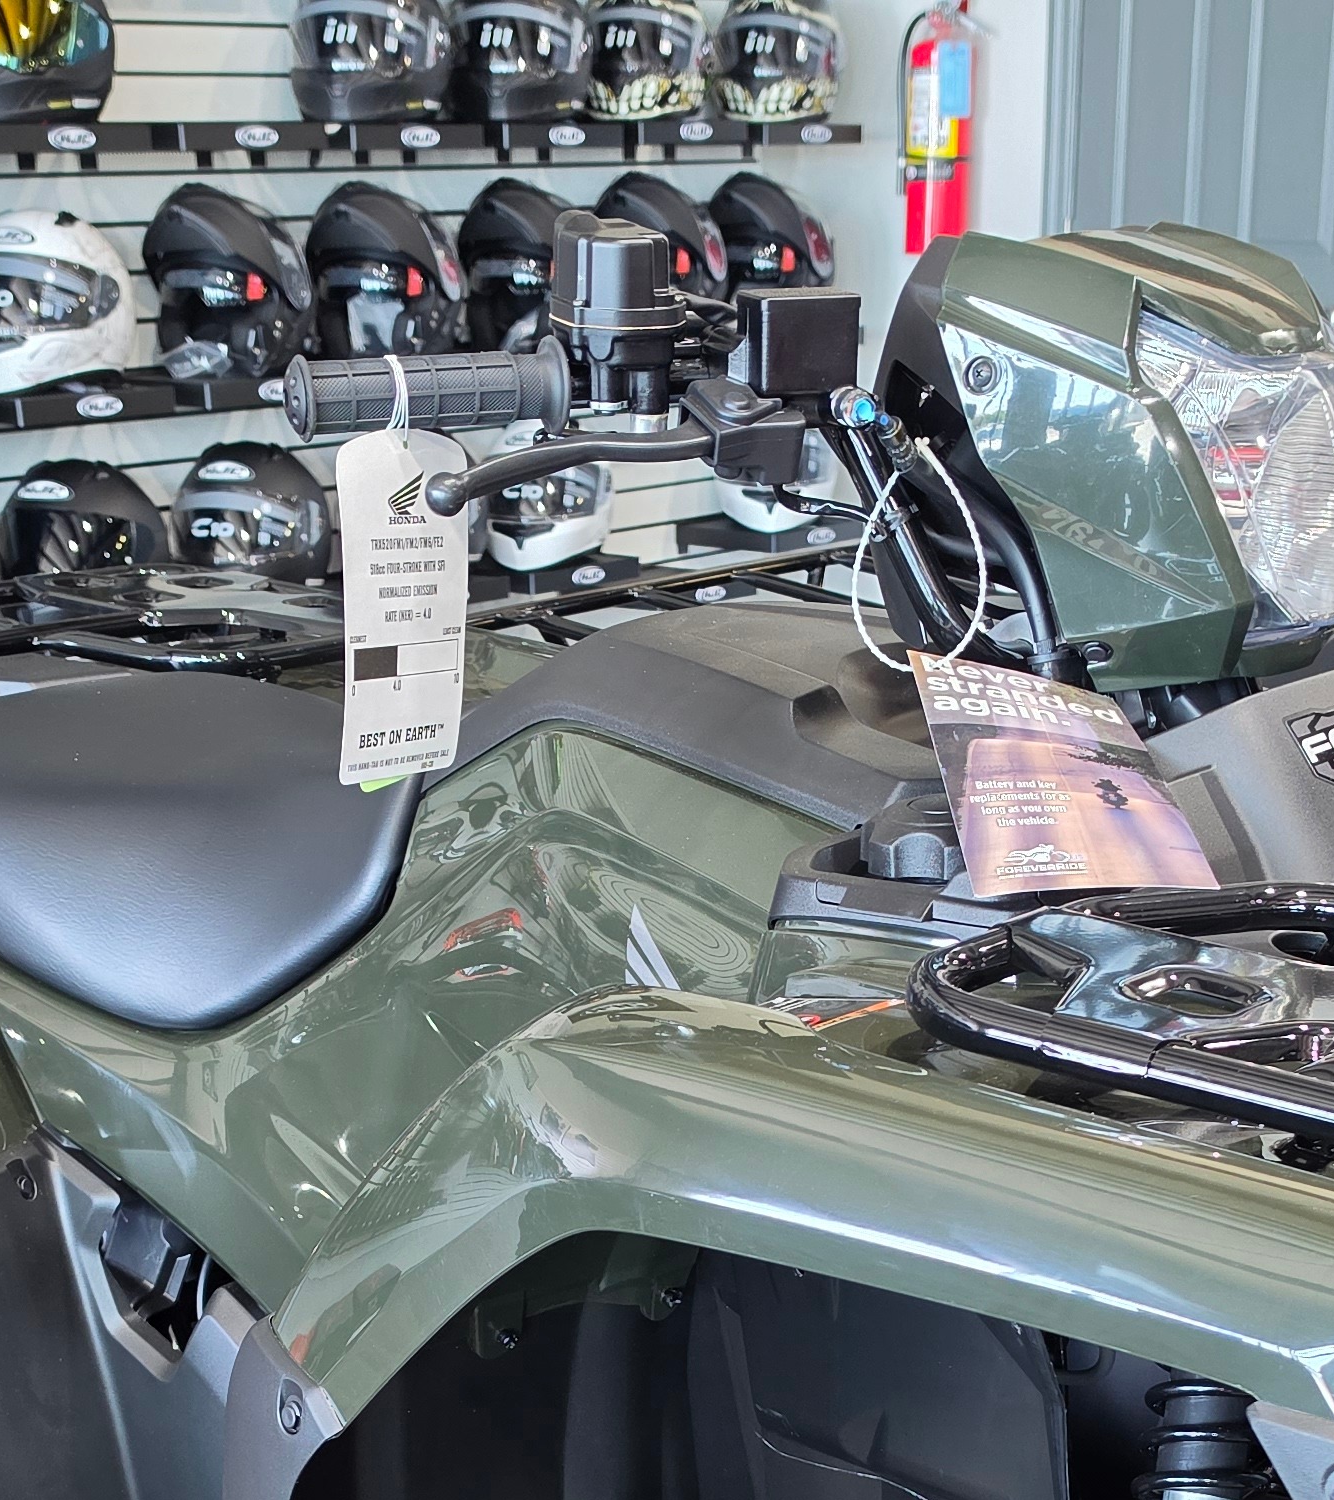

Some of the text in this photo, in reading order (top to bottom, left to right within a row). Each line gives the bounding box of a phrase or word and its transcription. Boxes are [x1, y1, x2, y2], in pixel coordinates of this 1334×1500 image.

[388, 515, 427, 525] HONDA
[190, 517, 235, 539] C10
[386, 561, 422, 574] FOUR-STROKE
[378, 584, 438, 599] NORMALIZED EMISSION
[385, 611, 397, 622] RATE
[399, 609, 414, 622] (NER)
[423, 608, 432, 619] 4.0
[454, 673, 460, 684] 10
[920, 655, 1049, 693] Never
[393, 680, 401, 691] 4.0
[927, 675, 1124, 726] stranded
[934, 694, 1072, 727] again.
[359, 732, 386, 749] BEST
[389, 729, 402, 745] ON
[975, 779, 1056, 790] Battery and key
[969, 791, 1071, 803] replacements for as
[980, 805, 1067, 816] long as you own
[997, 816, 1059, 827] the vehicle.
